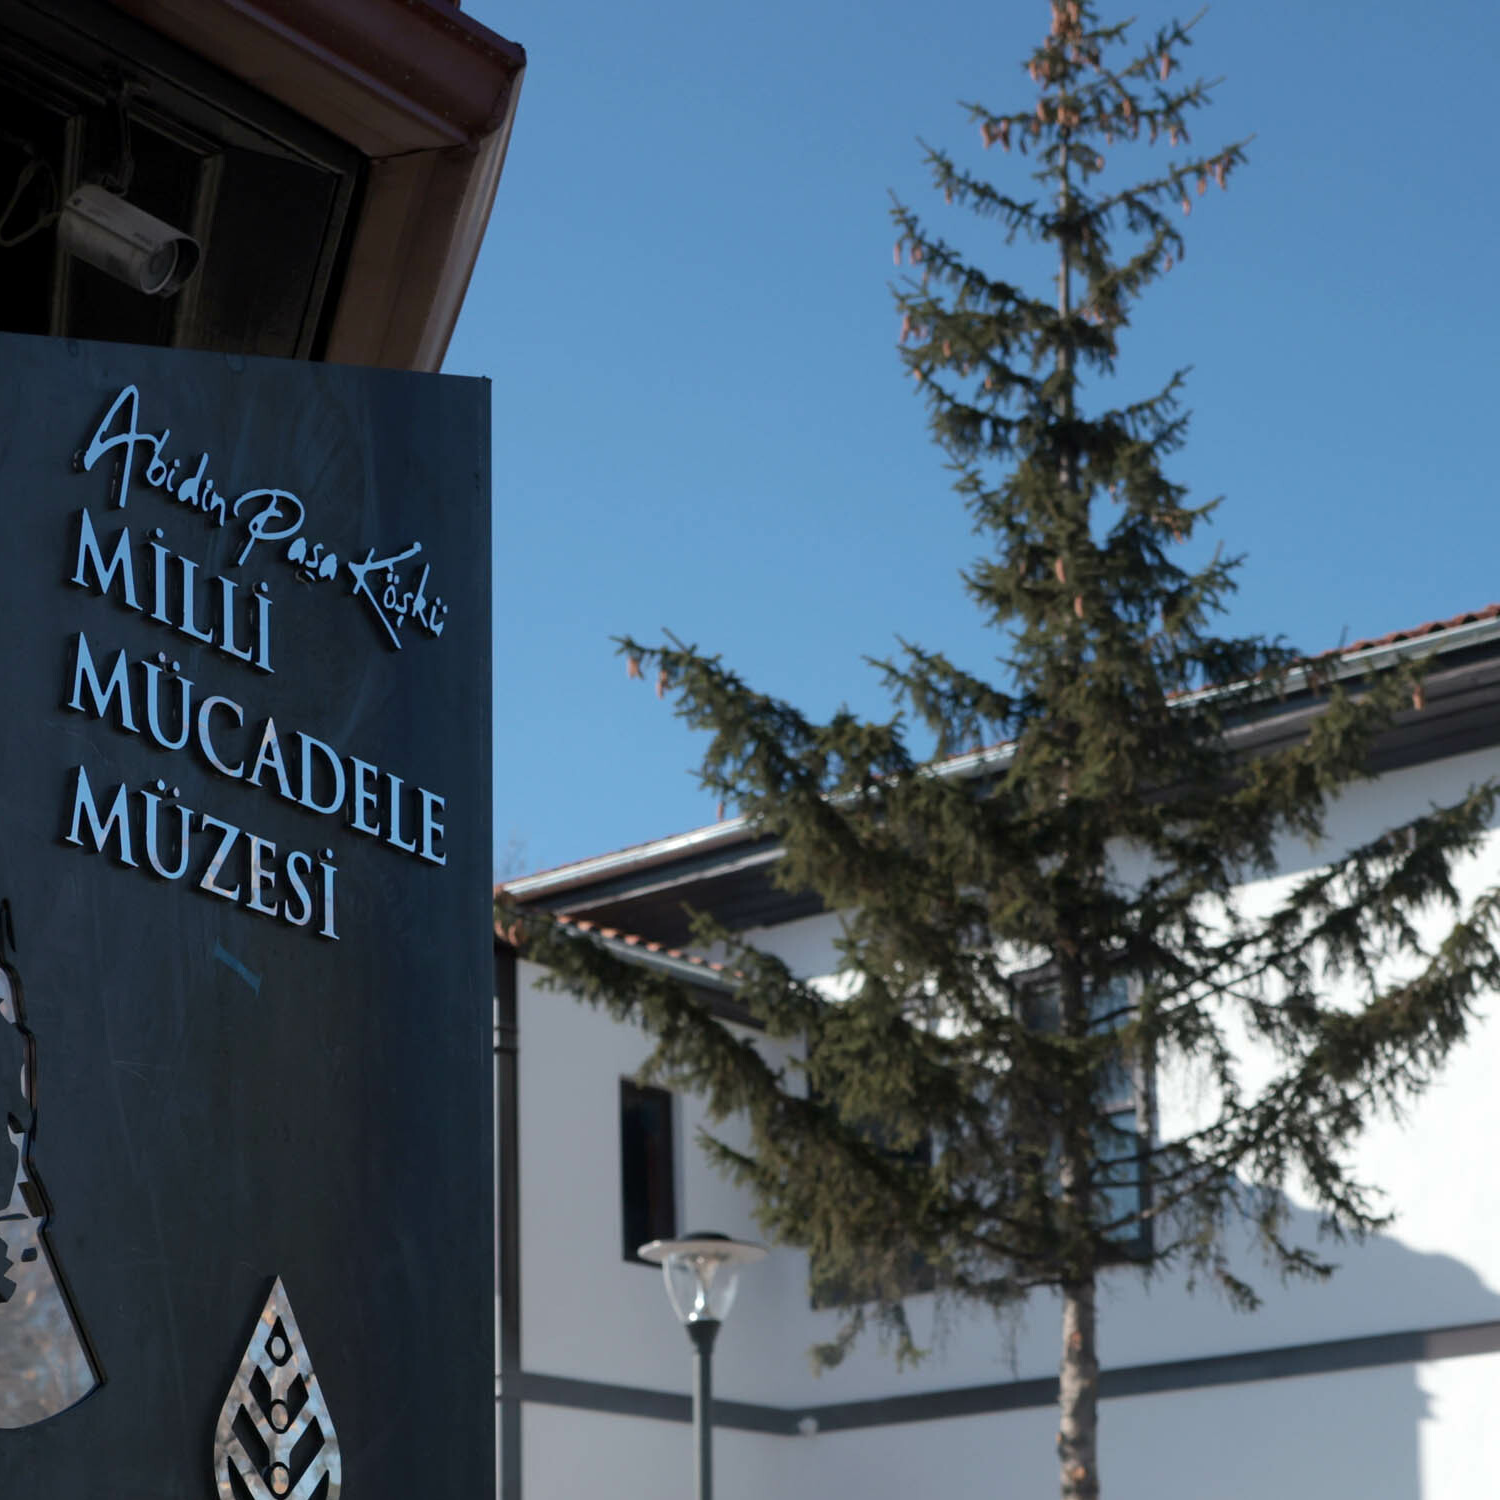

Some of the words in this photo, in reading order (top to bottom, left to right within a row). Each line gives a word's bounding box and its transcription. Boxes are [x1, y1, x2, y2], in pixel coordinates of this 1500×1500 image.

[71, 507, 275, 673] MİLLİ
[84, 384, 227, 527] Abidin
[233, 488, 338, 582] Paşa
[347, 540, 449, 650] Köşkü
[68, 631, 447, 866] MÜCADELE
[65, 764, 340, 941] MÜZESİ
